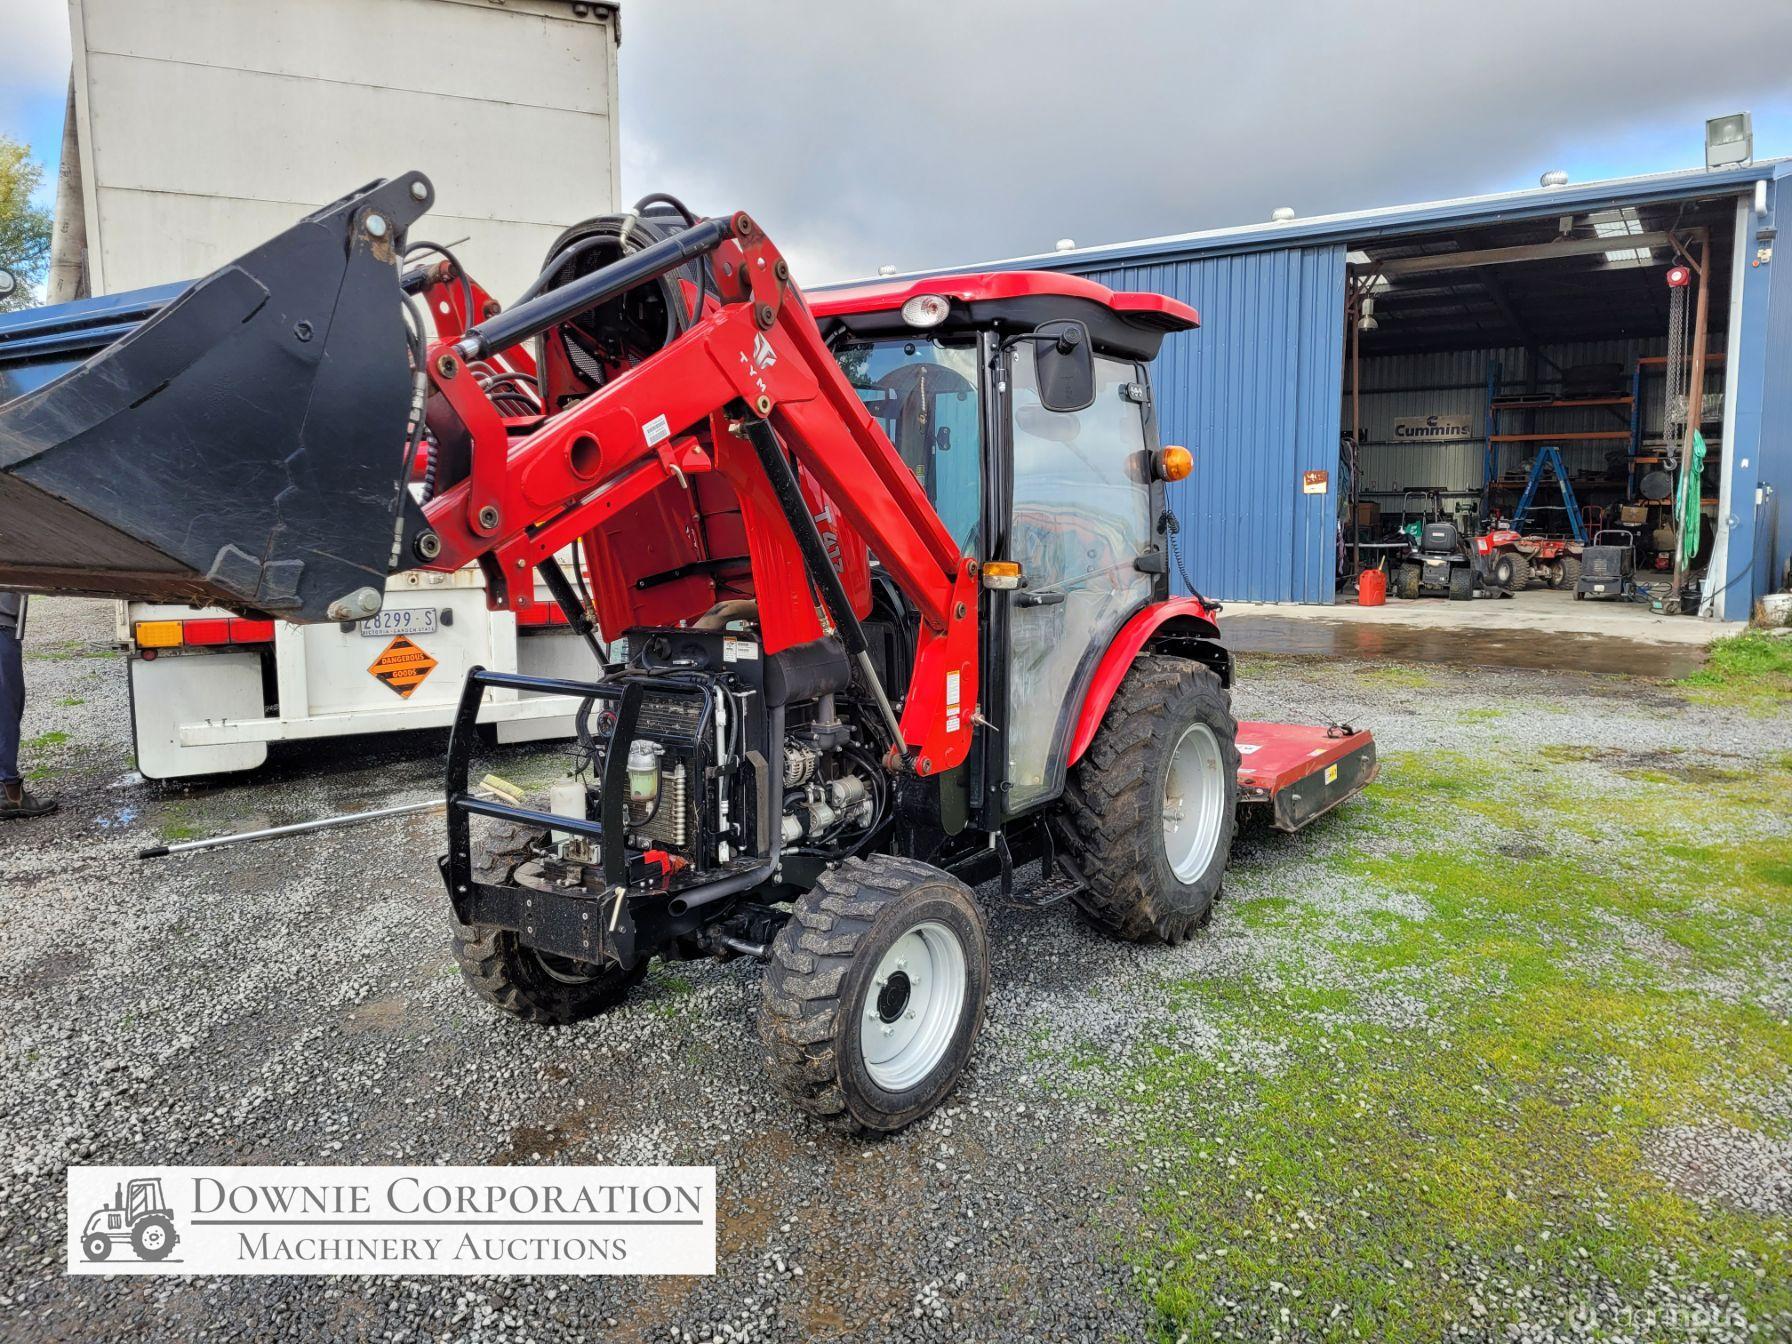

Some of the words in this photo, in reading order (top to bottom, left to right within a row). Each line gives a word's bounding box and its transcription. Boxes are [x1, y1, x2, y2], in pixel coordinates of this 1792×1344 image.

[1394, 423, 1471, 437] Cummins
[381, 653, 425, 665] DANGEROUS
[392, 668, 417, 678] GOODS
